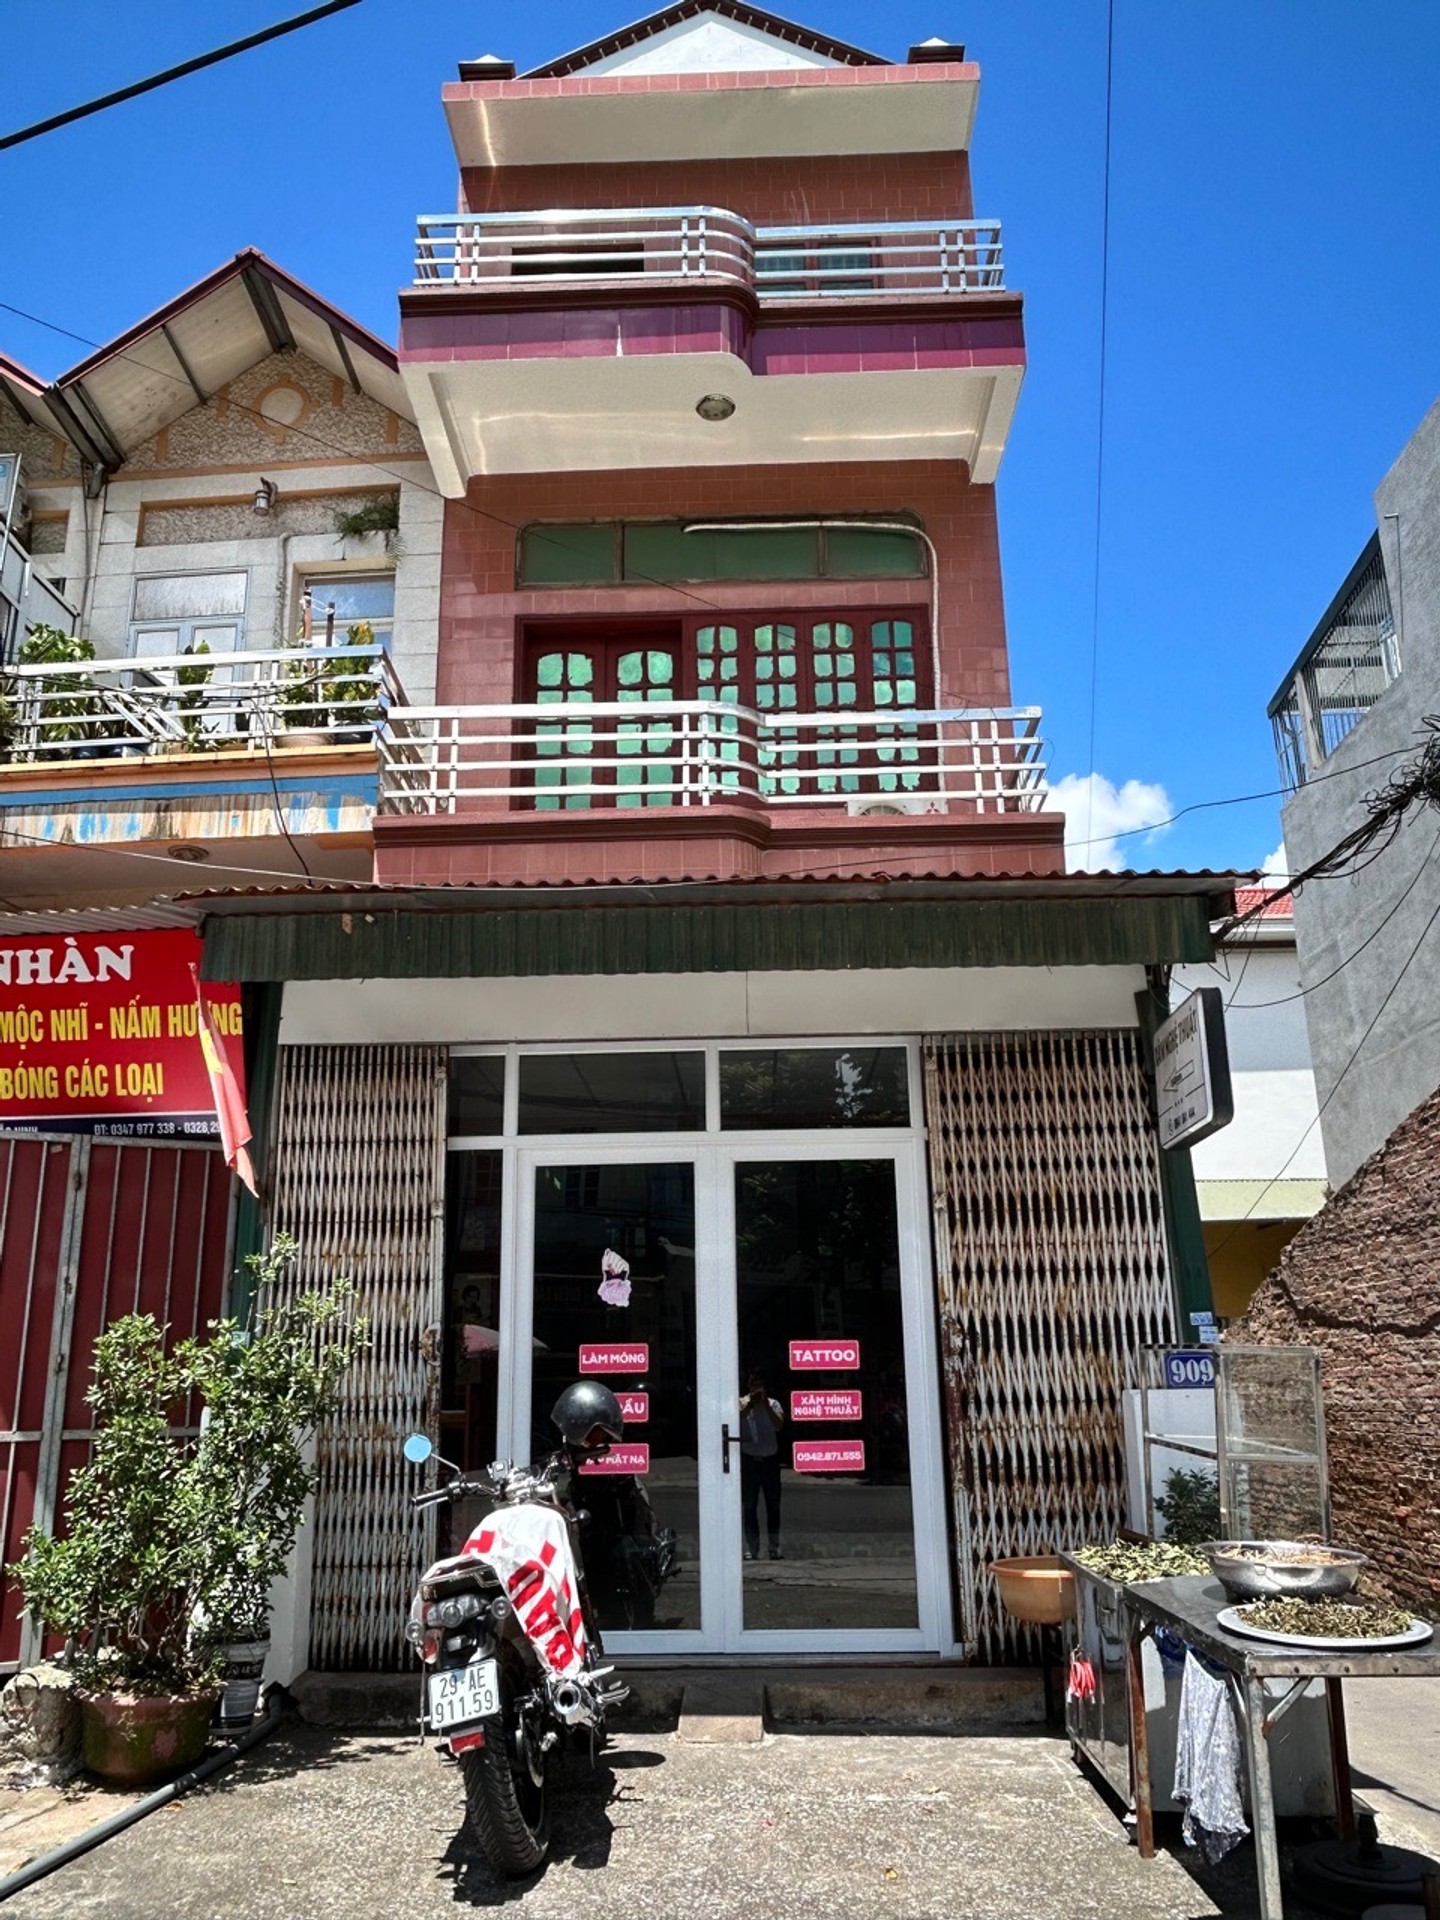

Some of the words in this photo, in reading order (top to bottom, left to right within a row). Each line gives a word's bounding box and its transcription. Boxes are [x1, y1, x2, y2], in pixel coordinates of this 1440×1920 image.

[0, 1004, 44, 1050] MỘC
[51, 1002, 88, 1042] NHĨ
[109, 994, 161, 1039] NẤM
[168, 1001, 243, 1038] HƯNG
[0, 1061, 59, 1100] BÓNG
[65, 1058, 109, 1098] CÁC
[115, 1062, 164, 1103] LOẠI
[110, 1123, 134, 1135] 0347
[136, 1123, 154, 1135] 977
[157, 1122, 175, 1134] 338
[582, 1352, 608, 1365] LÀM
[609, 1351, 646, 1364] MÓNG
[793, 1349, 856, 1362] TATTOO
[1170, 1359, 1215, 1383] 909
[440, 1667, 486, 1699] 29-AE
[435, 1689, 493, 1723] 911.59
